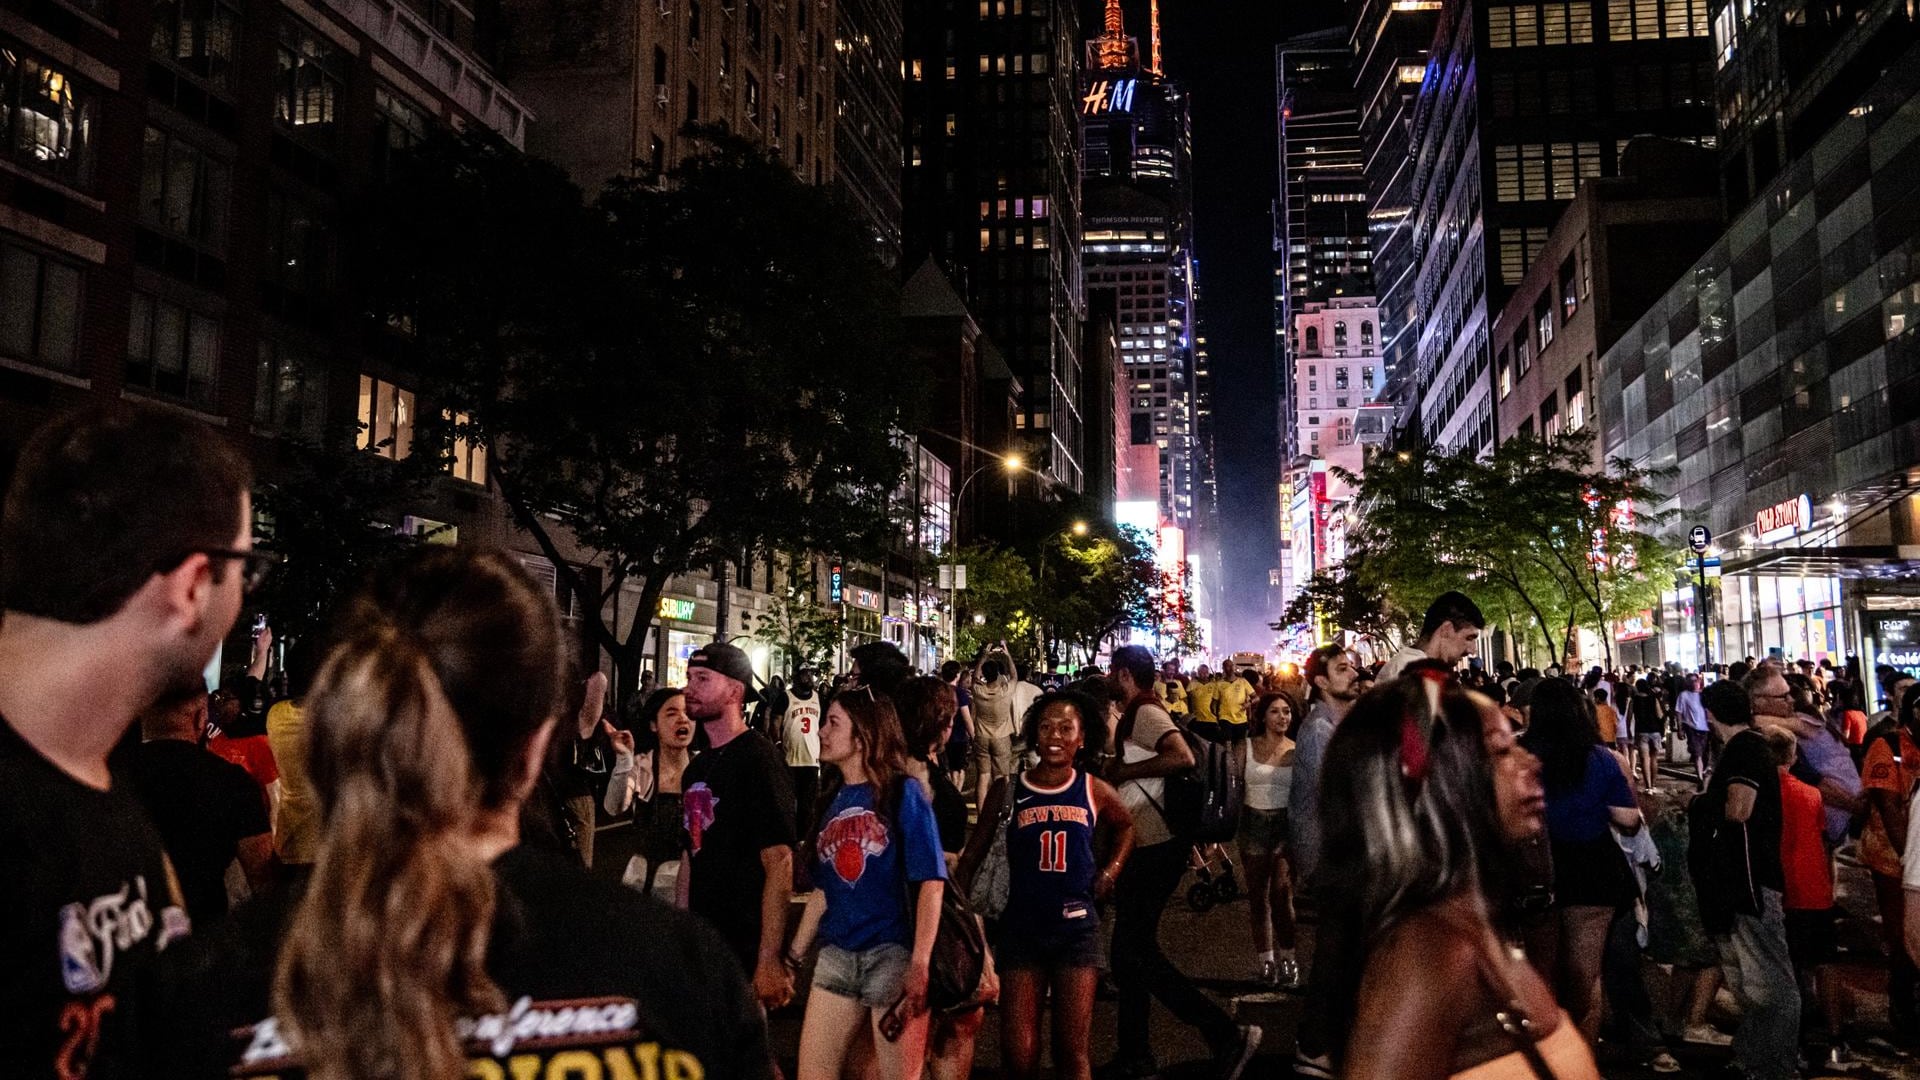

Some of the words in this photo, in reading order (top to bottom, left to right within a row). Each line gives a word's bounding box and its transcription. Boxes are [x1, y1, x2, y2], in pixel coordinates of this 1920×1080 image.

[1083, 79, 1136, 115] H&M
[1091, 216, 1129, 224] THOMSON
[1757, 507, 1775, 540] COLD
[1775, 498, 1799, 528] STONE
[832, 574, 841, 598] GYM
[659, 597, 695, 620] SUBWAY
[800, 717, 811, 734] 3
[1018, 805, 1050, 829] NEW
[1049, 804, 1089, 827] YORK
[1039, 830, 1067, 872] 11
